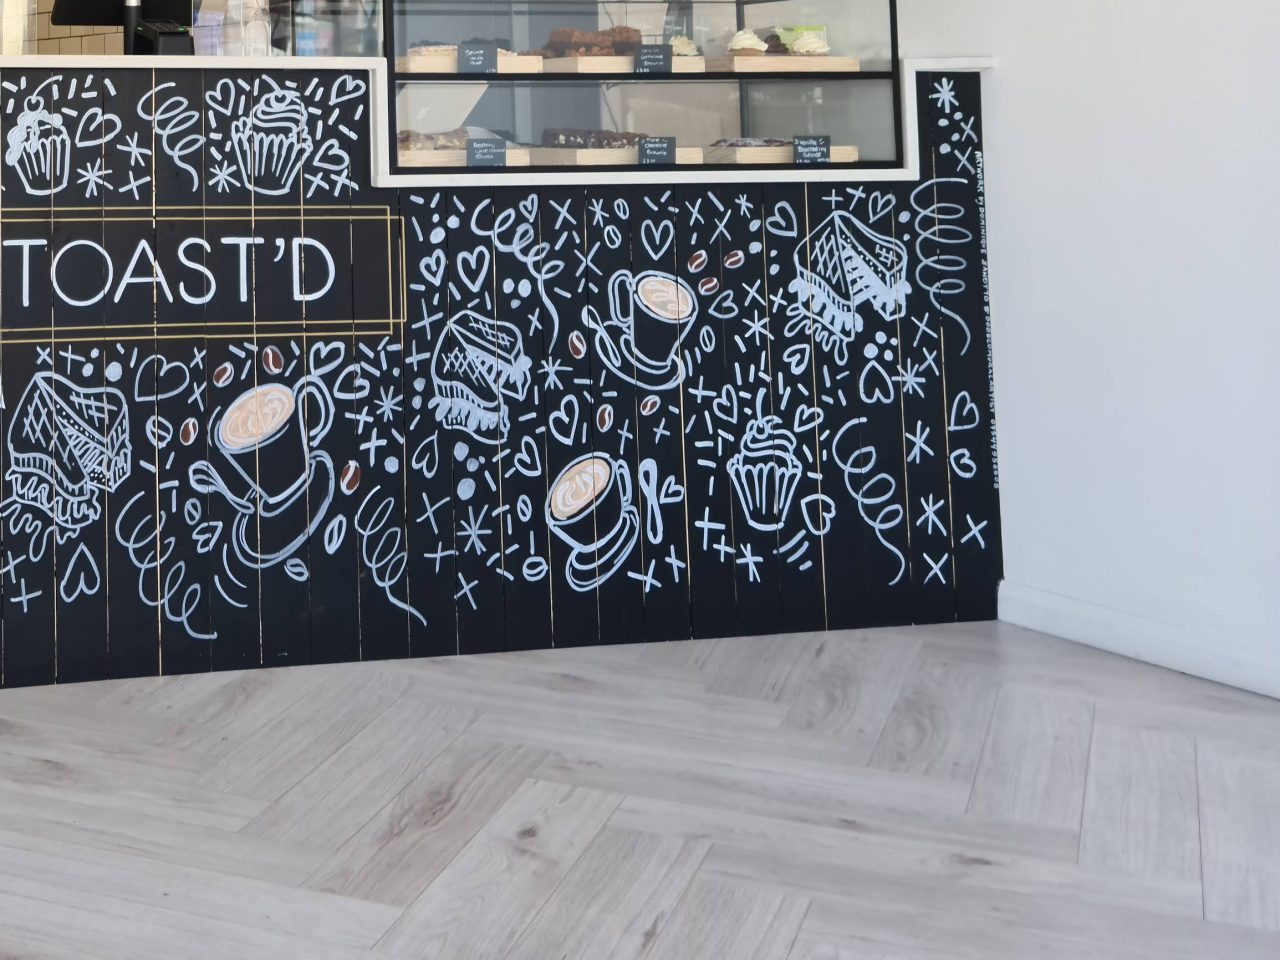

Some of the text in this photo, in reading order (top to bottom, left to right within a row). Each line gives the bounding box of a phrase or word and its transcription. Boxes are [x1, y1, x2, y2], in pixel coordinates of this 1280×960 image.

[974, 150, 984, 193] ARTWORK
[975, 196, 983, 205] by
[978, 206, 987, 255] DOMINIQUE
[3, 237, 336, 306] TOAST'D
